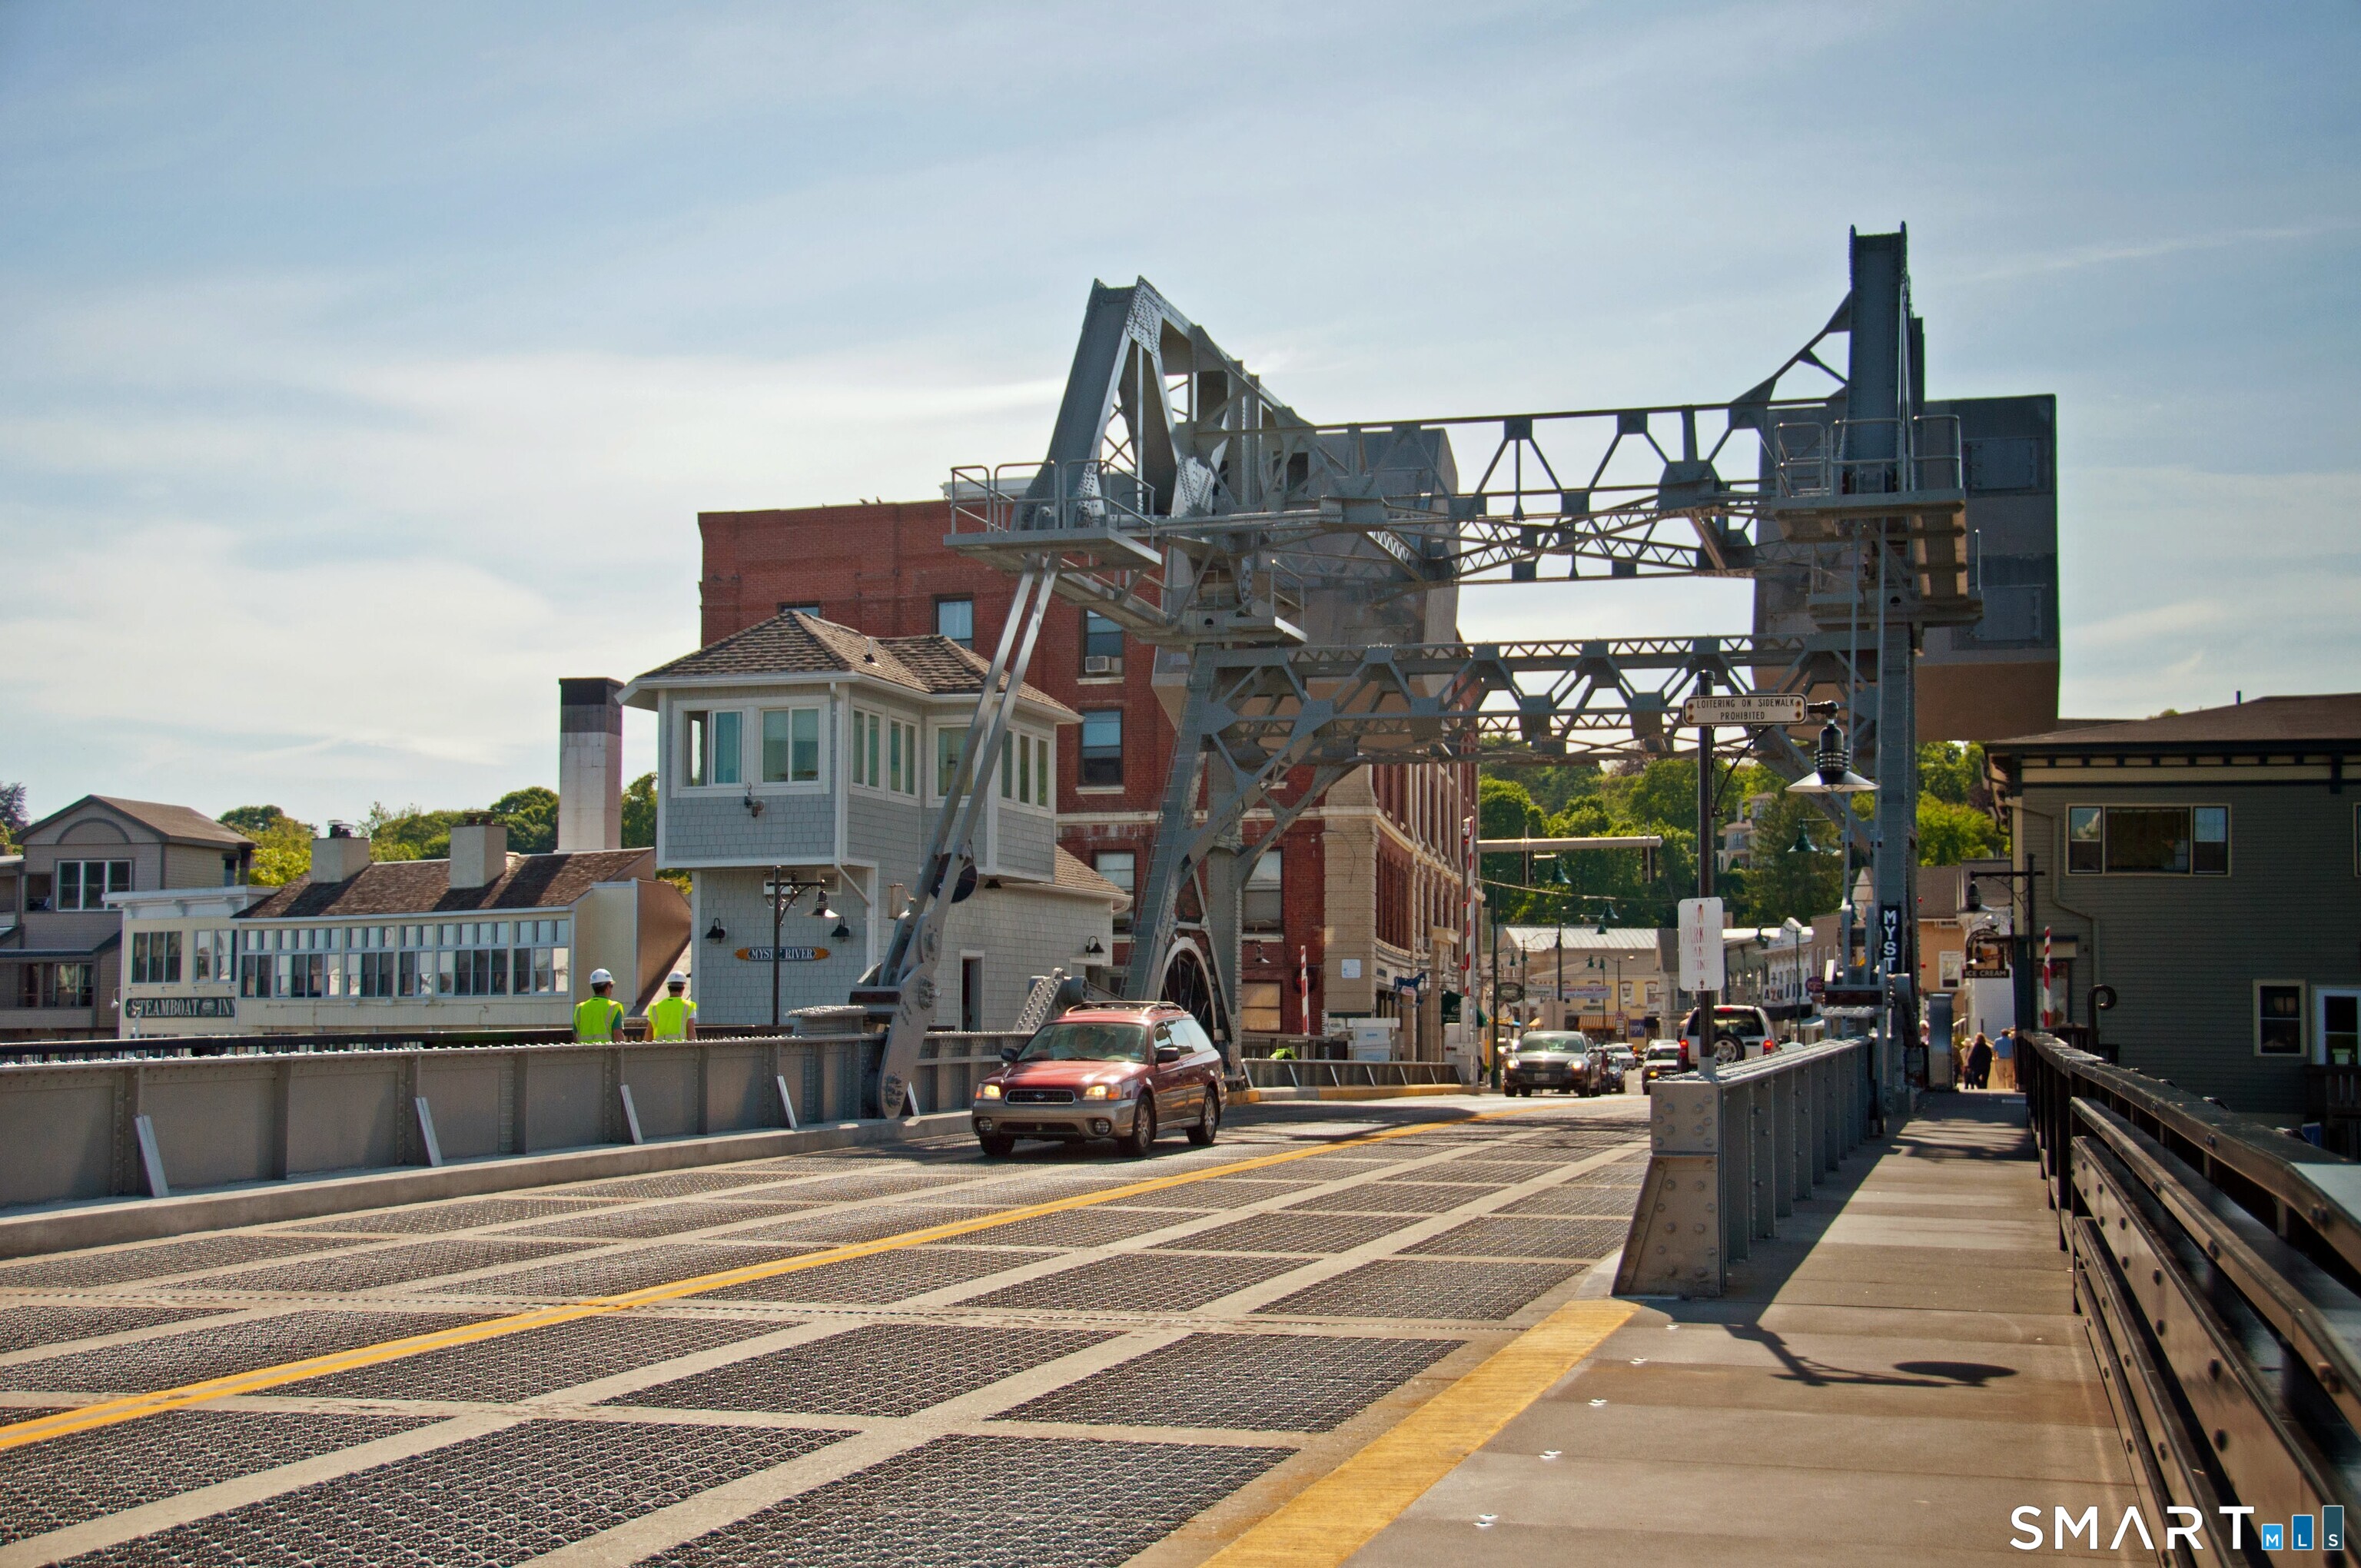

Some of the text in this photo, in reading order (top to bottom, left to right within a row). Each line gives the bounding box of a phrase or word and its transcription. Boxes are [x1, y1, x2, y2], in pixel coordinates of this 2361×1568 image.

[1697, 698, 1795, 709] LOITERING ON SIDEWALK
[1720, 712, 1765, 720] PROHIBITED
[785, 948, 813, 959] RIVER
[131, 999, 200, 1015] STEAMBOAT
